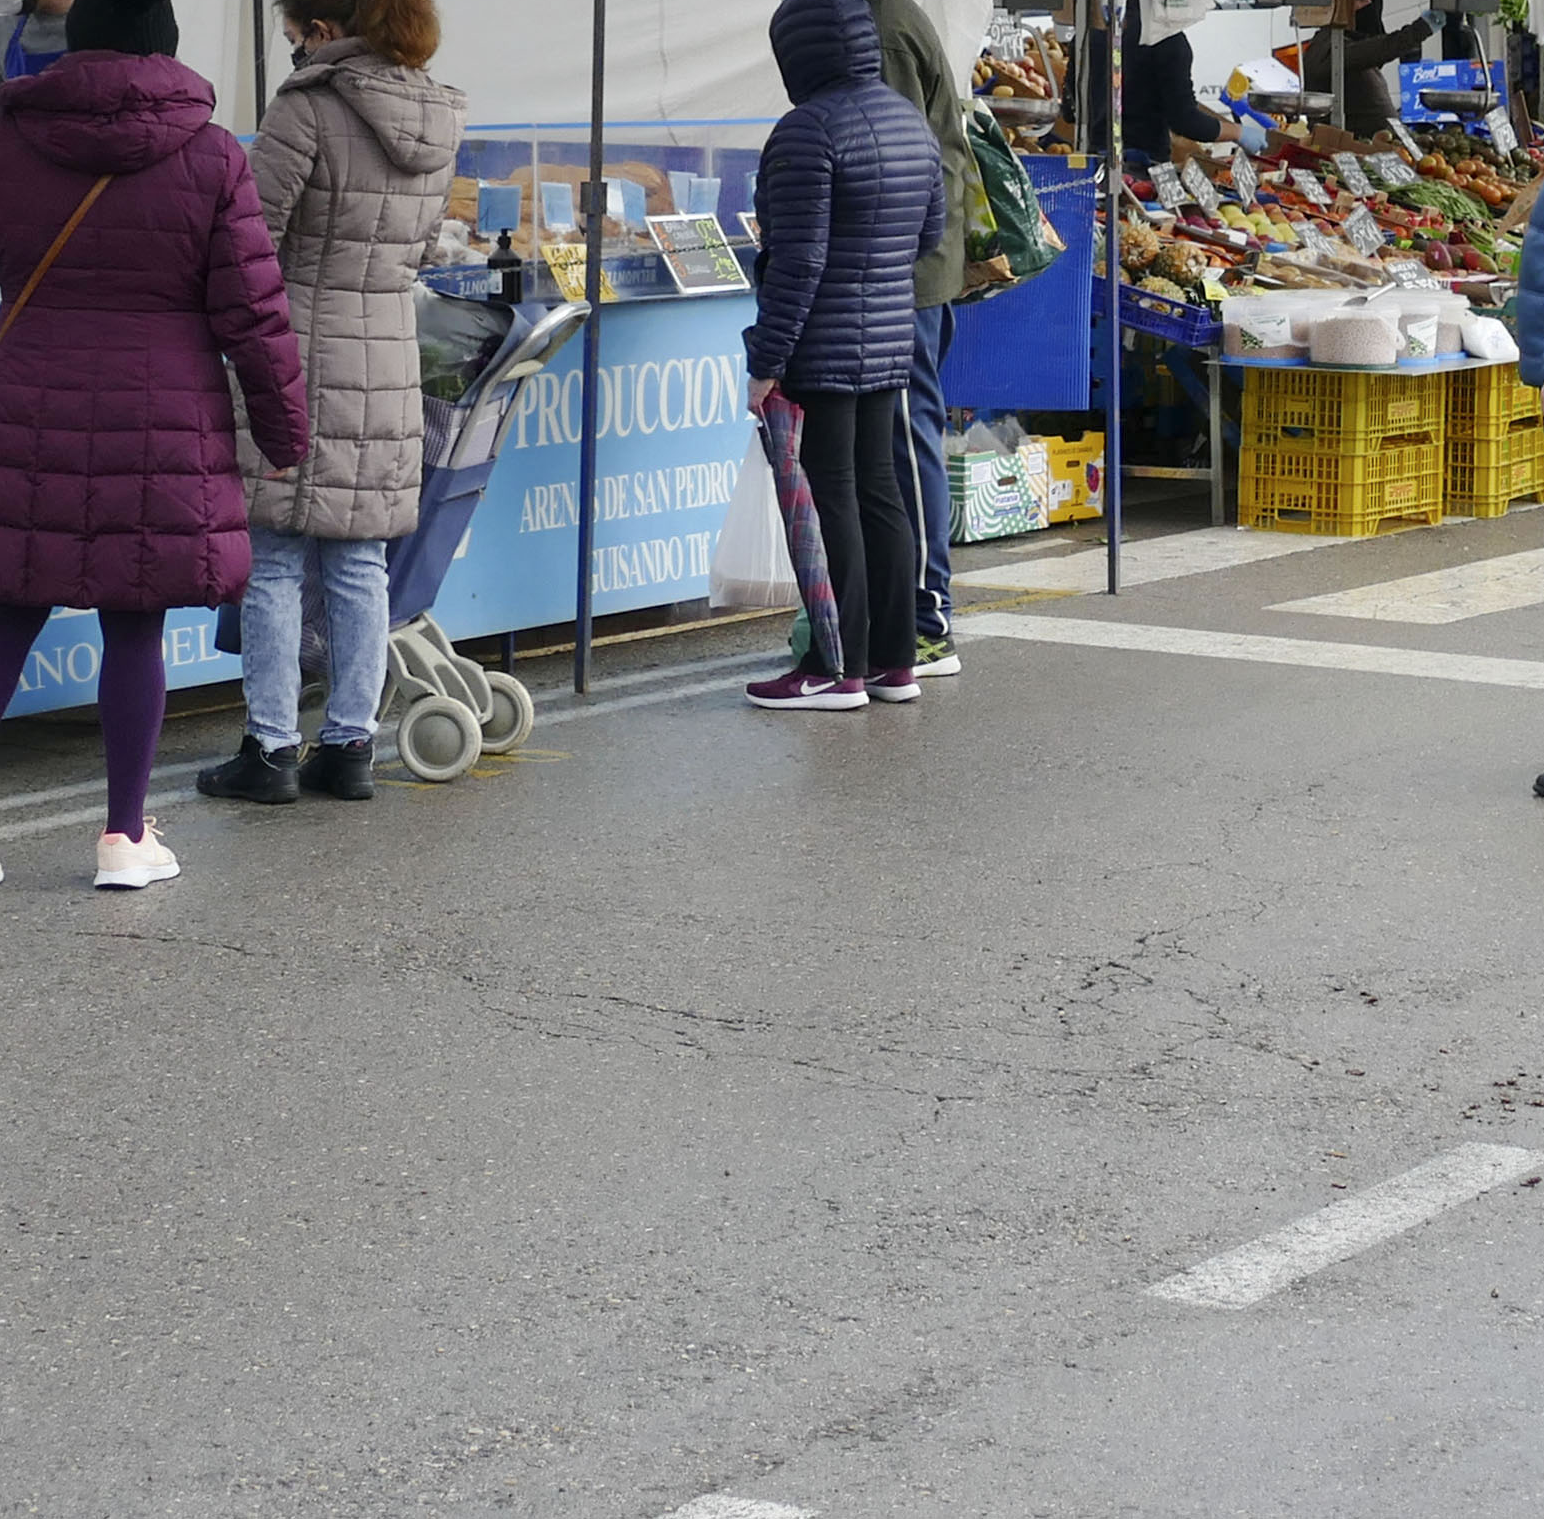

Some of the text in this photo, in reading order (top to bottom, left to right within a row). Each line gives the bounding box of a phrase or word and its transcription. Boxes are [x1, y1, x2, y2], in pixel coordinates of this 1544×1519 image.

[603, 473, 630, 522] DE
[633, 467, 671, 518] SAN
[674, 458, 738, 512] PEDRO
